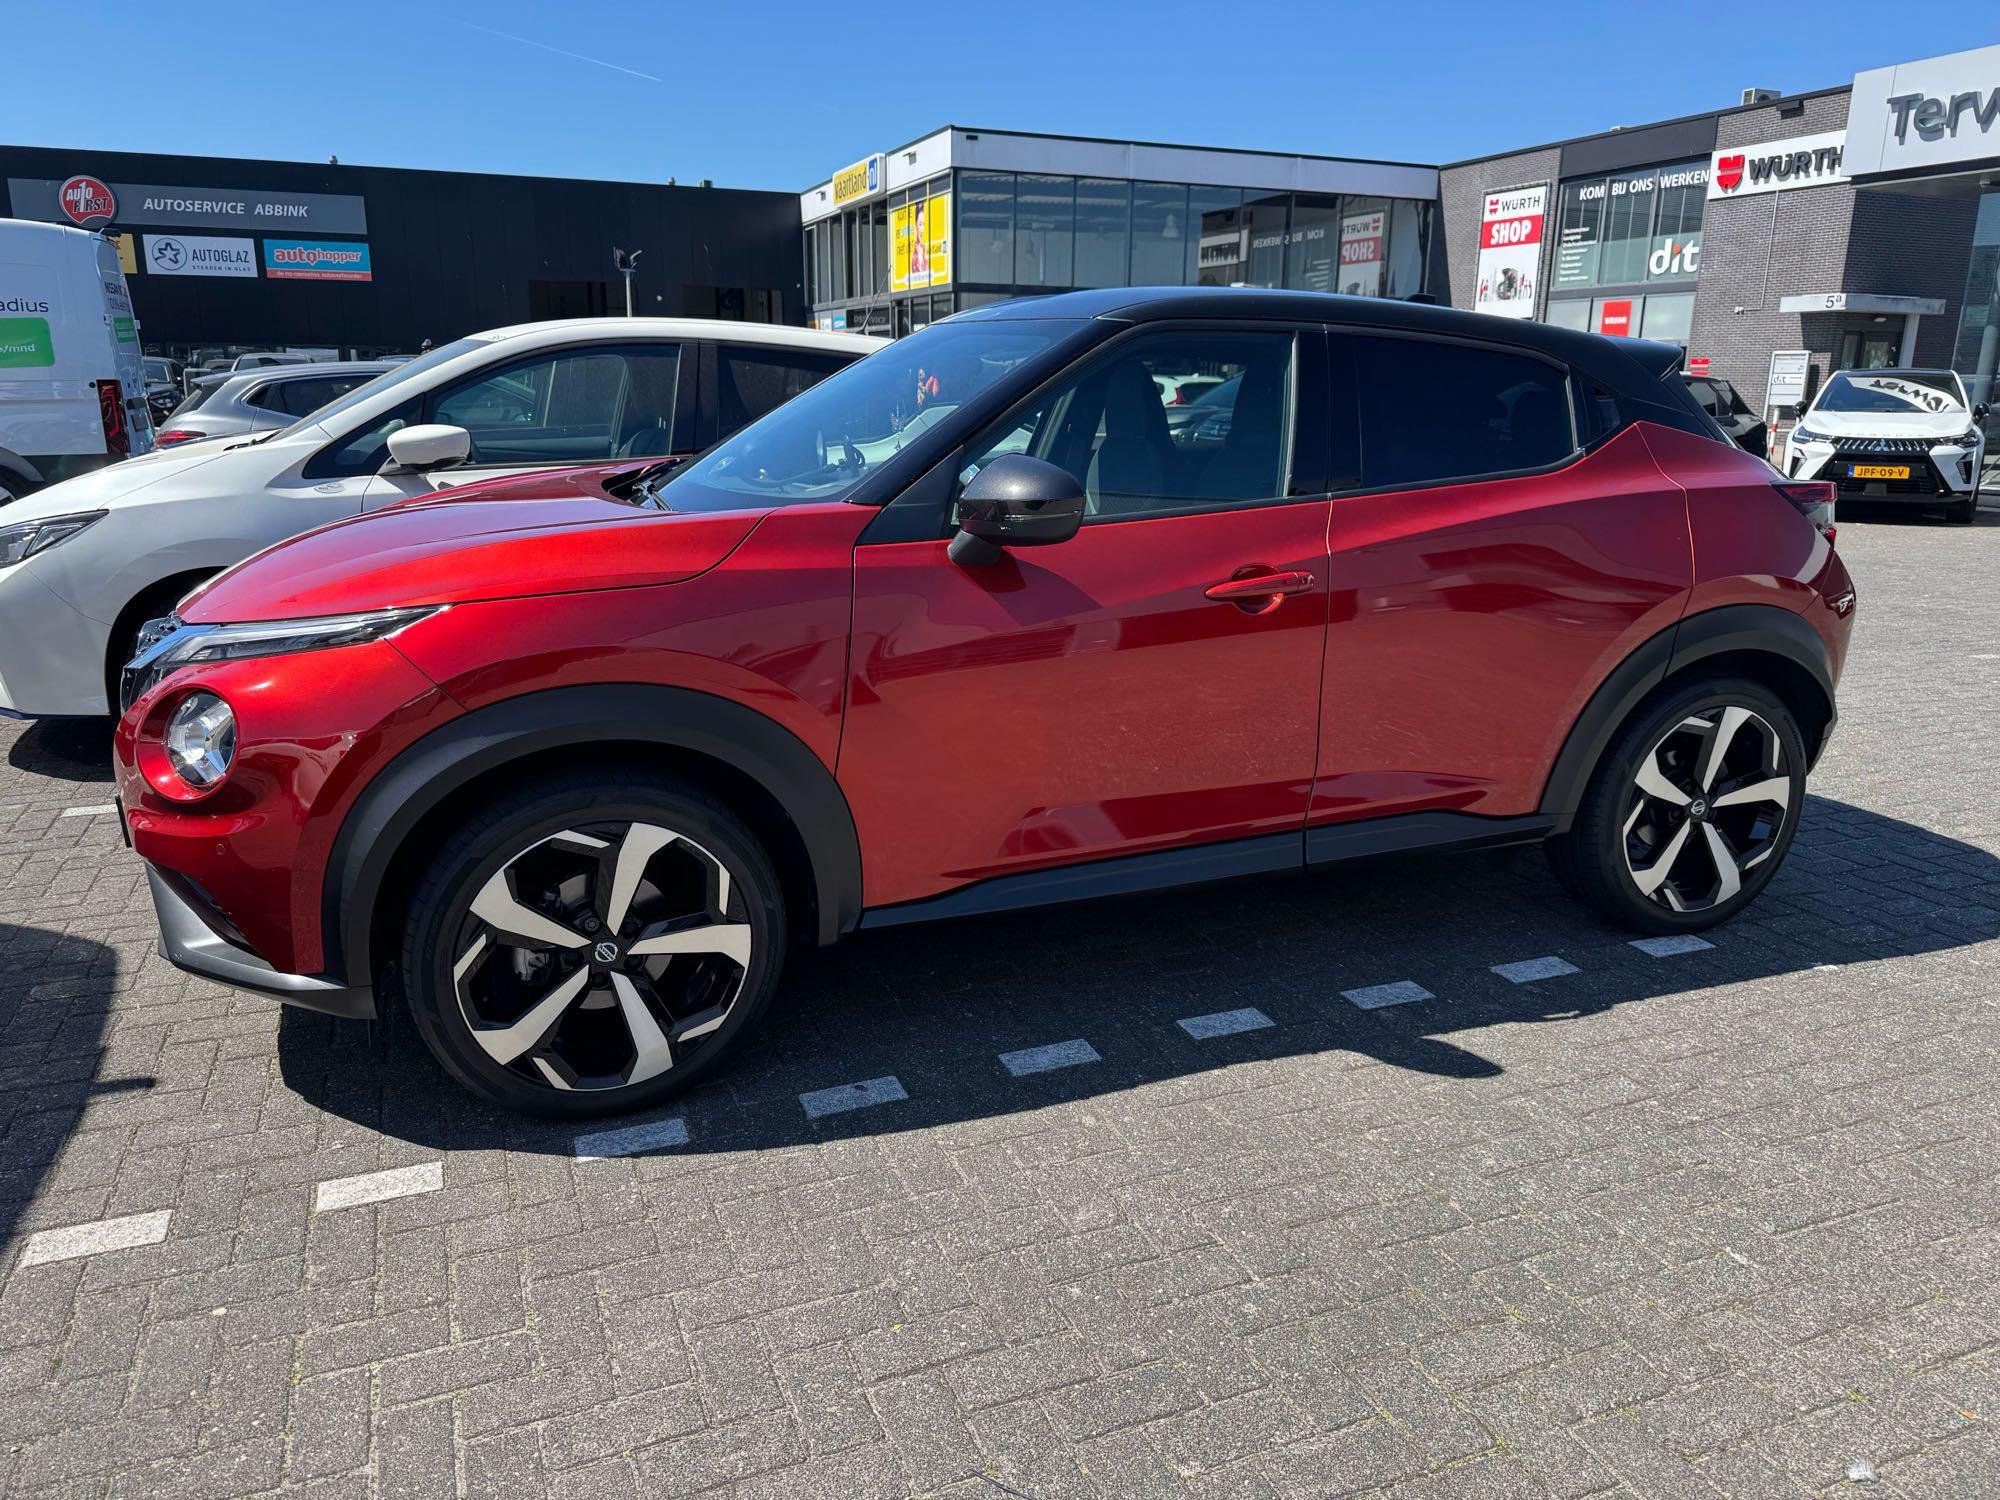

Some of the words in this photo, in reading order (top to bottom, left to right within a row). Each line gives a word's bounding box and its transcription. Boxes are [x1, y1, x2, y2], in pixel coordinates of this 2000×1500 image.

[1749, 145, 1844, 183] WÜRTH
[1579, 184, 1606, 200] KOM
[1611, 181, 1627, 196] BIJ
[1629, 178, 1653, 193] ONS
[1660, 169, 1710, 189] WERKEN
[143, 198, 245, 215] AUTOSERVICE
[254, 203, 308, 218] ABBINK
[1501, 196, 1541, 212] WÜRTH
[1490, 220, 1532, 245] SHOP
[191, 249, 250, 263] AUTOGLAZ
[274, 247, 361, 266] autohopper
[1649, 238, 1700, 275] dit
[1857, 468, 1905, 477] JPF-09-V
